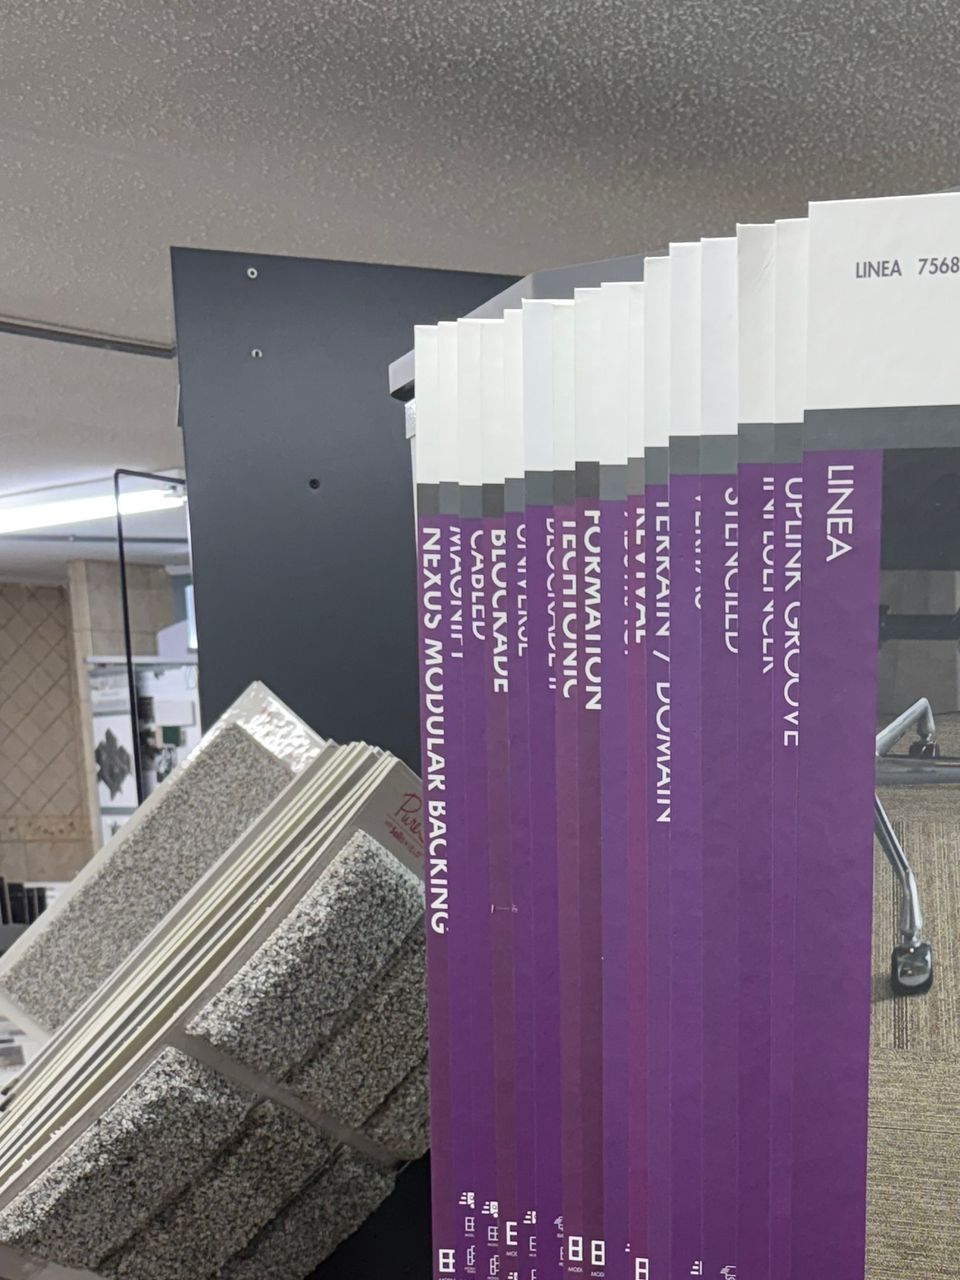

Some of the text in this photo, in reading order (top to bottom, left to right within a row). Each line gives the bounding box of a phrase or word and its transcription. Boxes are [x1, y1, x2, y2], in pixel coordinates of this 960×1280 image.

[856, 259, 902, 278] LINEA
[826, 464, 854, 562] LINEA
[491, 529, 508, 692] BLOCKADE
[584, 510, 602, 710] FORMATION
[422, 527, 450, 934] NEXUS MODULAR BACKING
